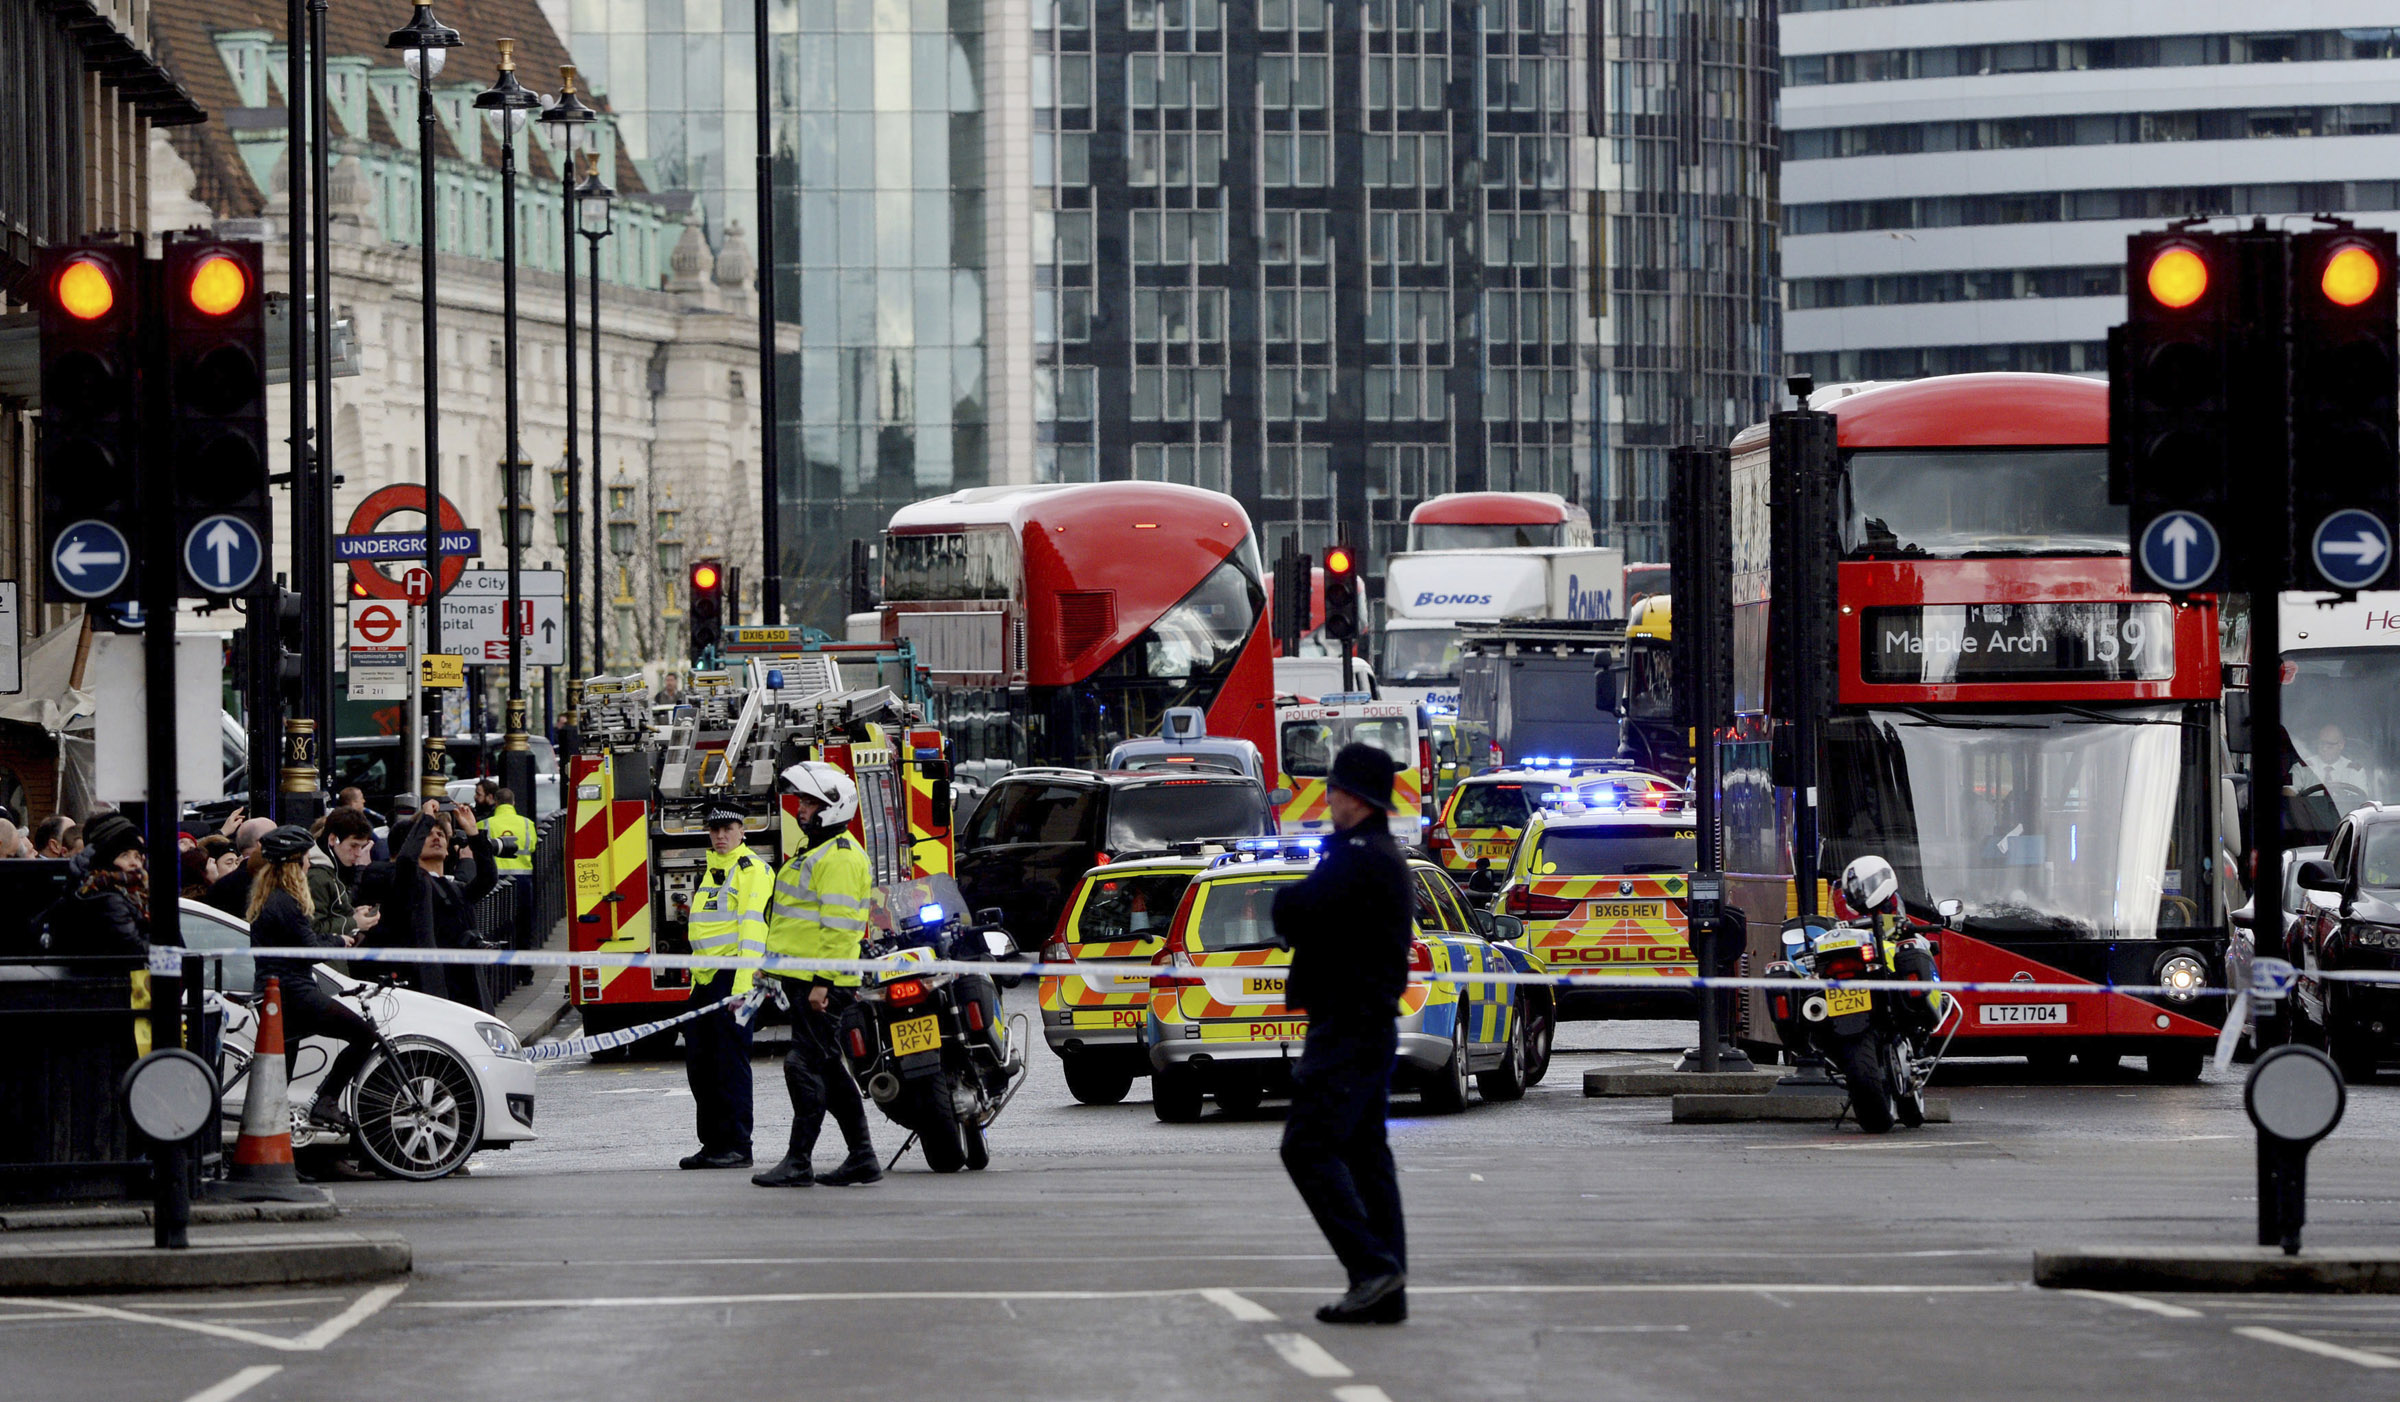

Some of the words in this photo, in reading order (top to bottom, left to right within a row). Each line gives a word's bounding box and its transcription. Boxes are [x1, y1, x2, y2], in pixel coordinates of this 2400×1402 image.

[407, 573, 426, 596] H
[456, 578, 472, 588] he
[478, 577, 506, 590] City
[1414, 592, 1492, 606] BONDS
[1568, 574, 1612, 620] BONDS
[421, 619, 474, 631] pital
[743, 631, 764, 640] DX16
[767, 631, 786, 640] ASO
[1885, 630, 1978, 653] Marble
[1986, 629, 2047, 653] Arch
[2086, 618, 2146, 662] 159
[445, 644, 480, 655] erloo
[1427, 692, 1462, 703] BON
[1285, 709, 1326, 720] POLICE
[1363, 706, 1403, 717] POLICE
[1674, 830, 1696, 840] AG
[1595, 905, 1630, 917] BX66
[1633, 905, 1658, 917] HEV
[1550, 947, 1699, 963] POLICE
[1253, 978, 1286, 991] BX6
[1835, 996, 1865, 1011] CZN
[1113, 1010, 1147, 1028] POL
[896, 1018, 933, 1038] BX12
[1250, 1022, 1309, 1041] POLIC
[900, 1032, 932, 1051] KFV
